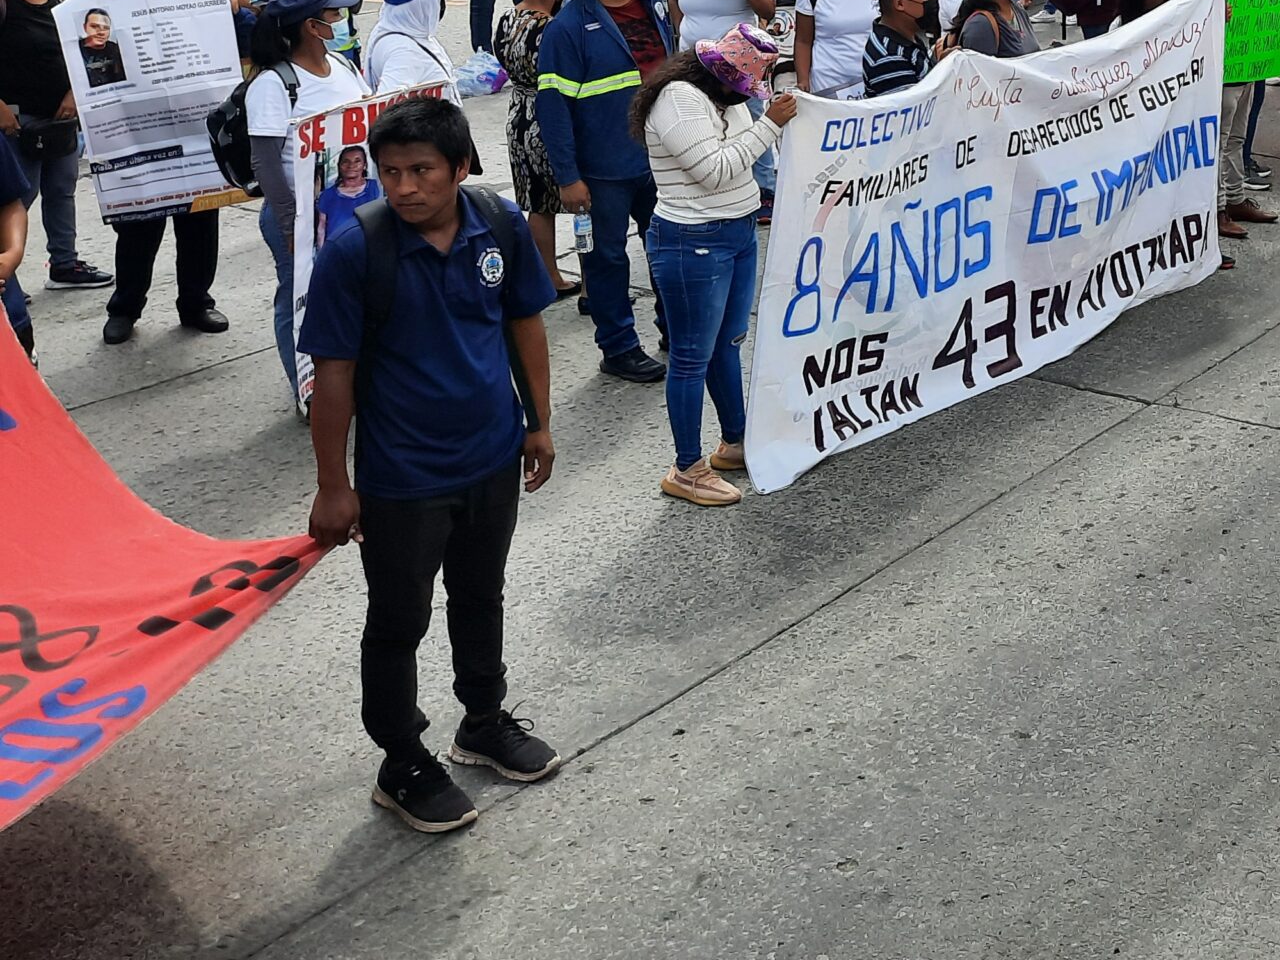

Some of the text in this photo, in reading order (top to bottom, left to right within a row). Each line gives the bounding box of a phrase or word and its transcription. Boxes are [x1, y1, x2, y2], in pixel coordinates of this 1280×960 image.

[298, 113, 326, 159] SE
[820, 154, 929, 207] FAMILIARES
[956, 135, 978, 169] DE
[1109, 94, 1135, 123] DE
[821, 96, 938, 152] COLECTIVO
[782, 237, 823, 338] 8
[832, 185, 993, 323] AÑOS
[1027, 179, 1082, 244] DE
[802, 332, 889, 396] NOS
[932, 280, 1023, 388] 43
[1030, 280, 1072, 339] EN
